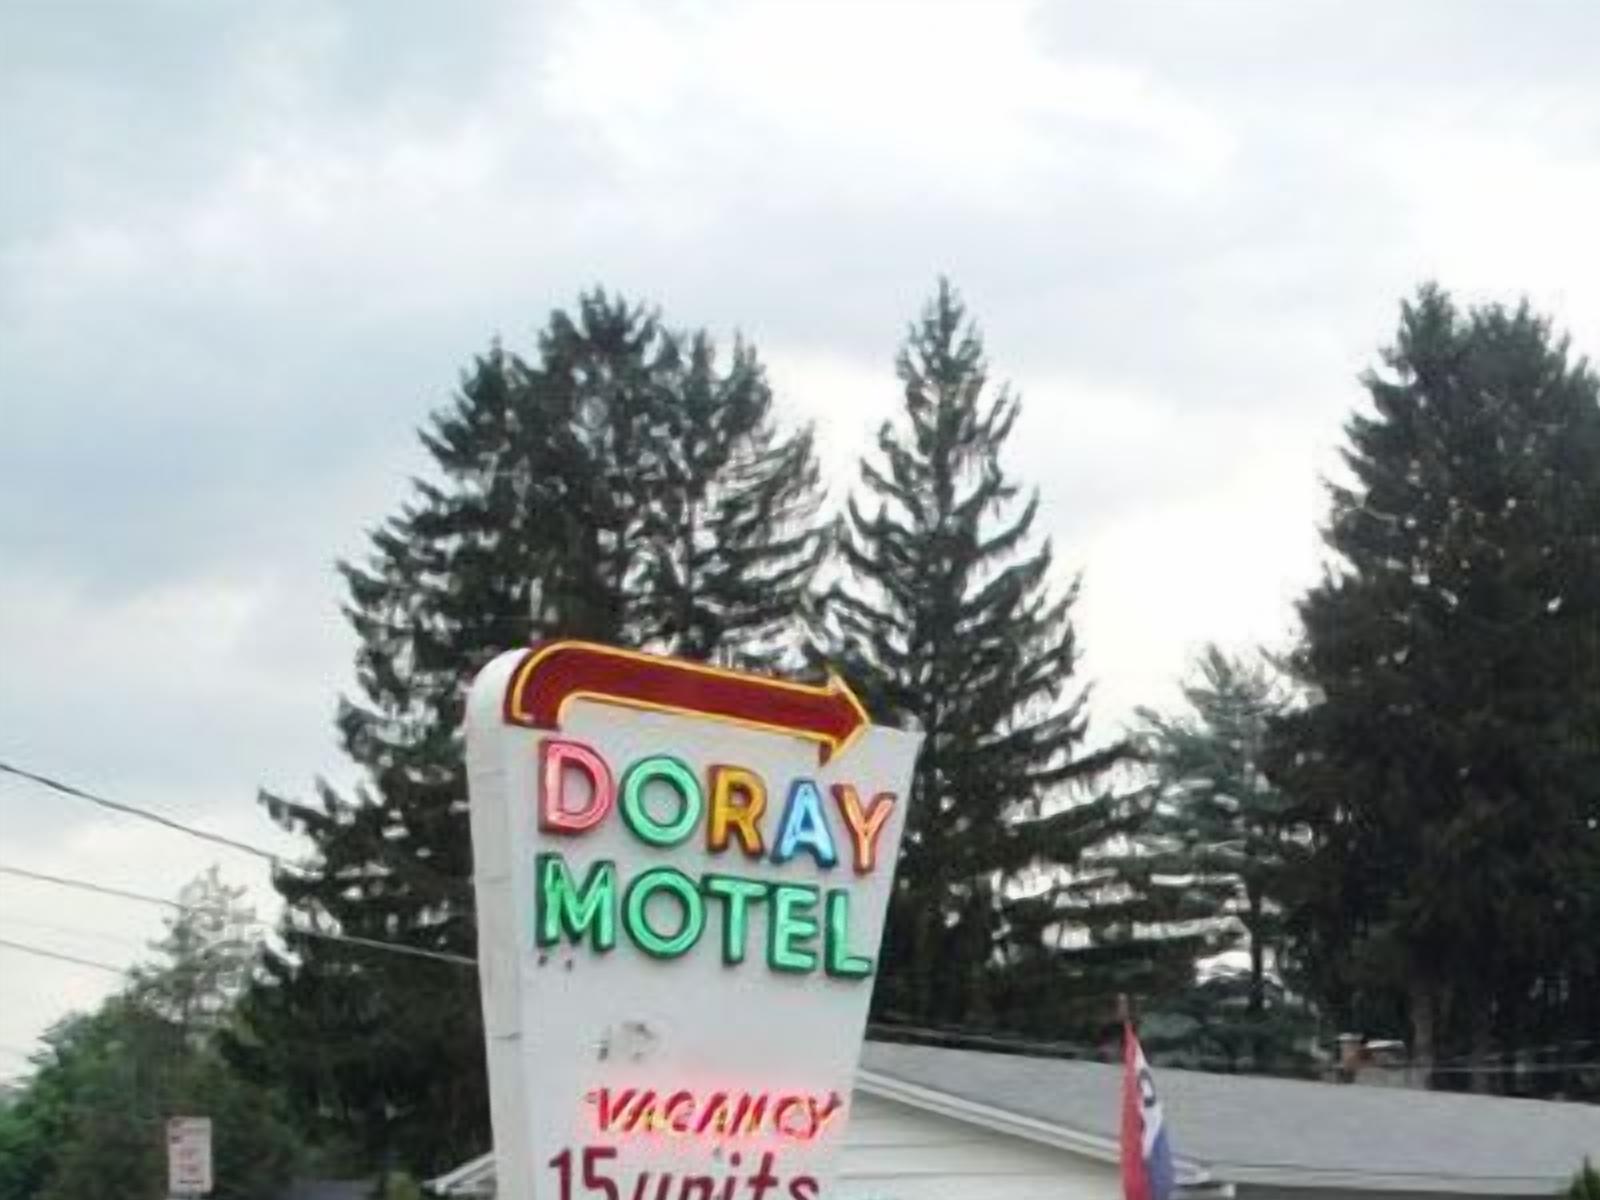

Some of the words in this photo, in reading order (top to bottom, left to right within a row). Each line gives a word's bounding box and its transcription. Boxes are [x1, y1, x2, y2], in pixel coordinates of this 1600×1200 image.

[539, 740, 896, 874] DORAY
[536, 852, 873, 979] MOTEL
[588, 1087, 843, 1140] VACANCY
